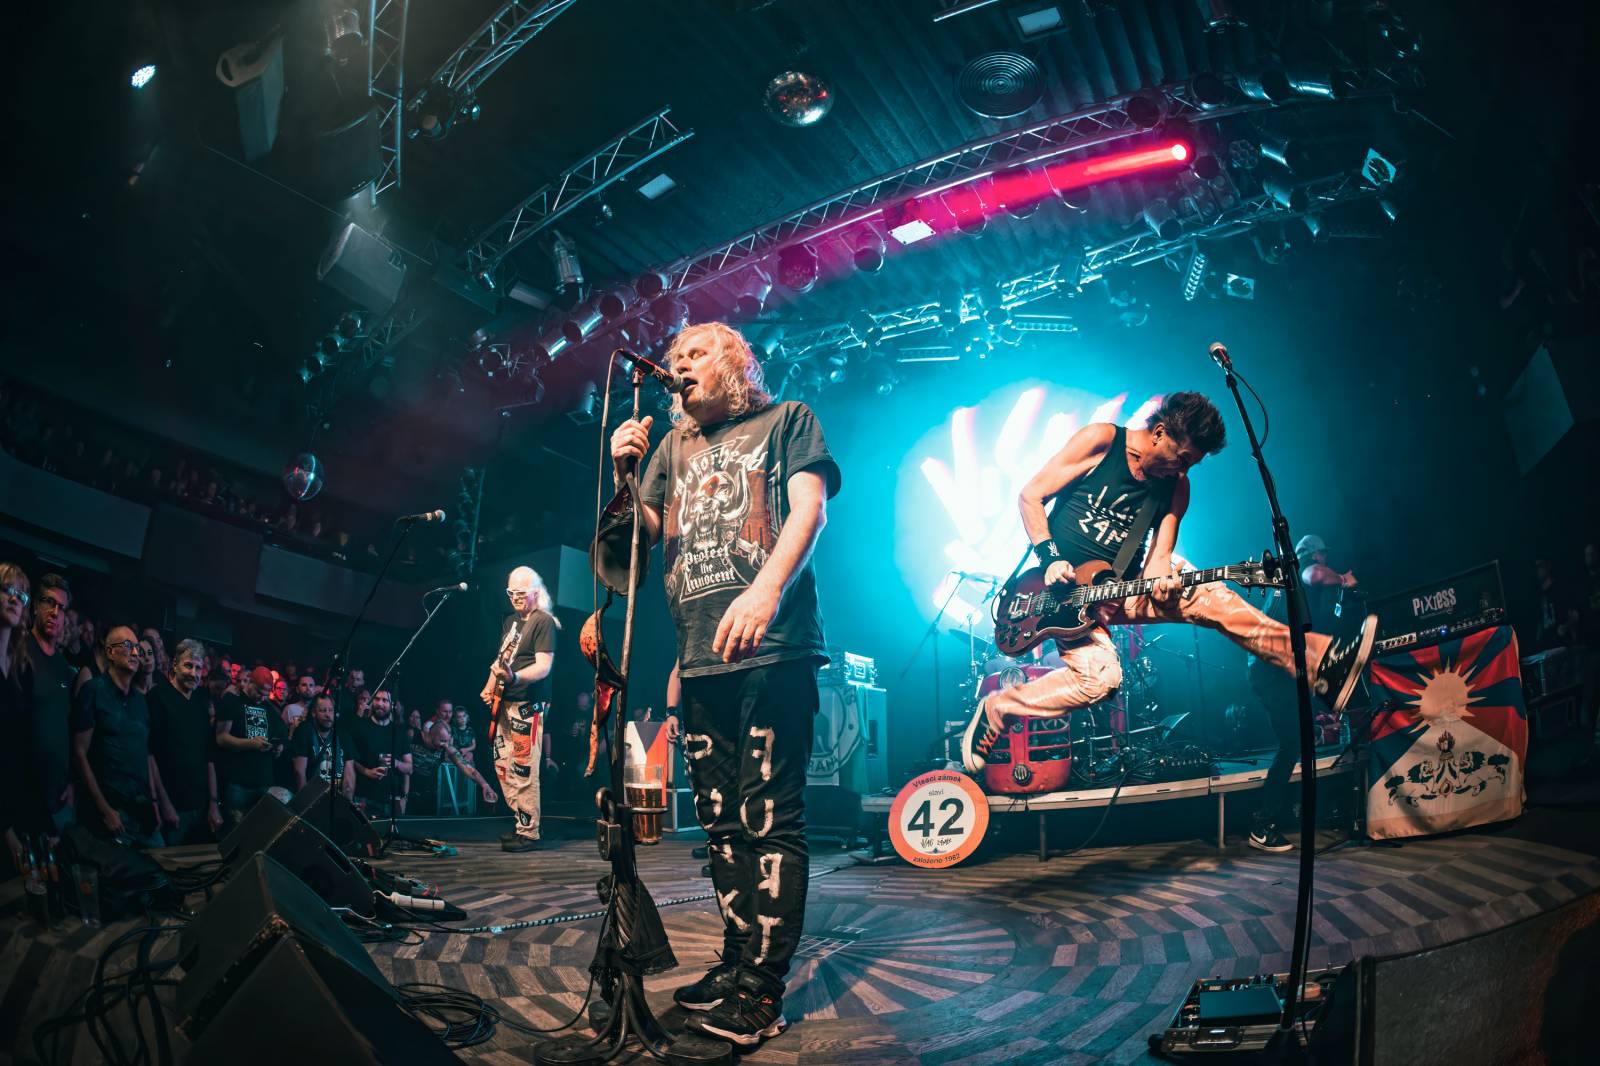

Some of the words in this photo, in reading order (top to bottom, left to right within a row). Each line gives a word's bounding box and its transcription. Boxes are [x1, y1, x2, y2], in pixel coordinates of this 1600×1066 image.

[684, 546, 729, 571] Protect
[700, 563, 713, 573] the
[685, 567, 736, 592] Innocent
[907, 797, 964, 838] 42
